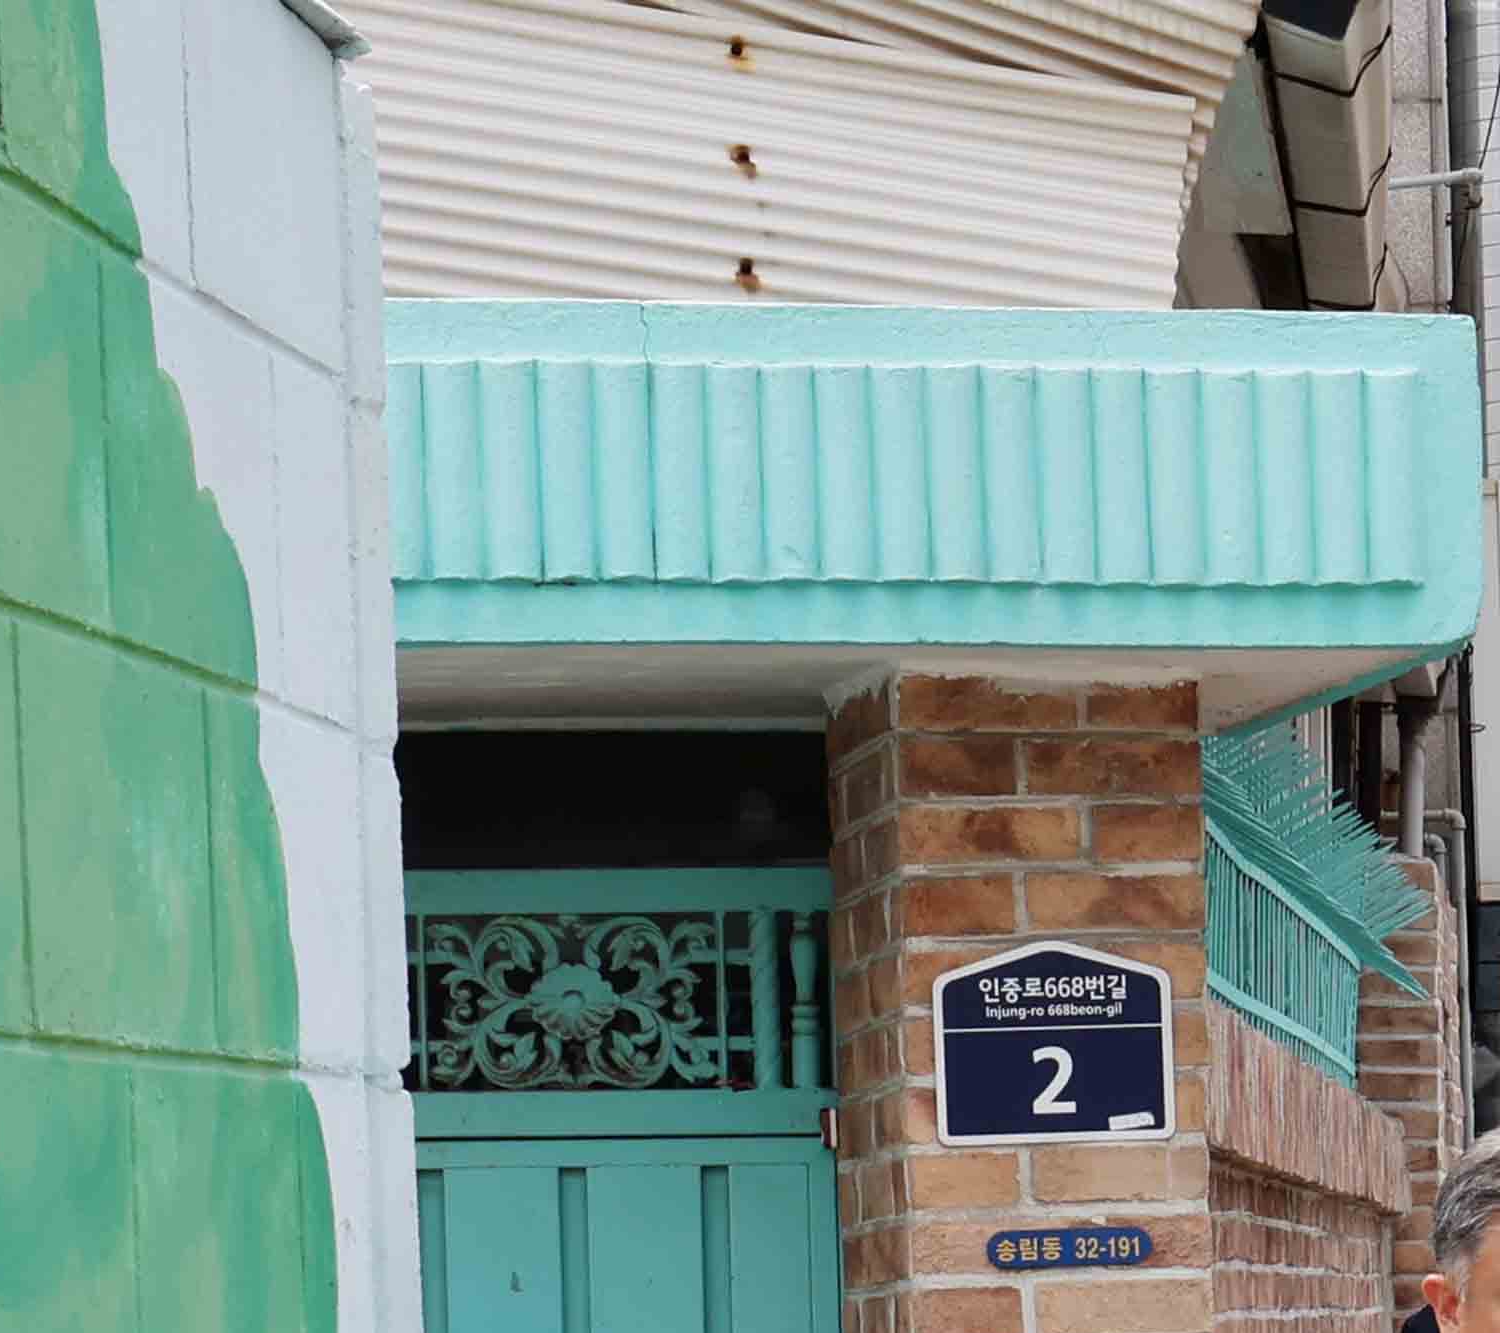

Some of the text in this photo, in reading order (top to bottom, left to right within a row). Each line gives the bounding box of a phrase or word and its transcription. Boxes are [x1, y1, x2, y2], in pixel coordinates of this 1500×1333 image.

[978, 974, 1128, 1004] 인중로668번길
[985, 1002, 1123, 1021] Injung-ro 668beon-gil
[1032, 1046, 1078, 1115] 2
[995, 1236, 1141, 1262] 송림동 32-191
